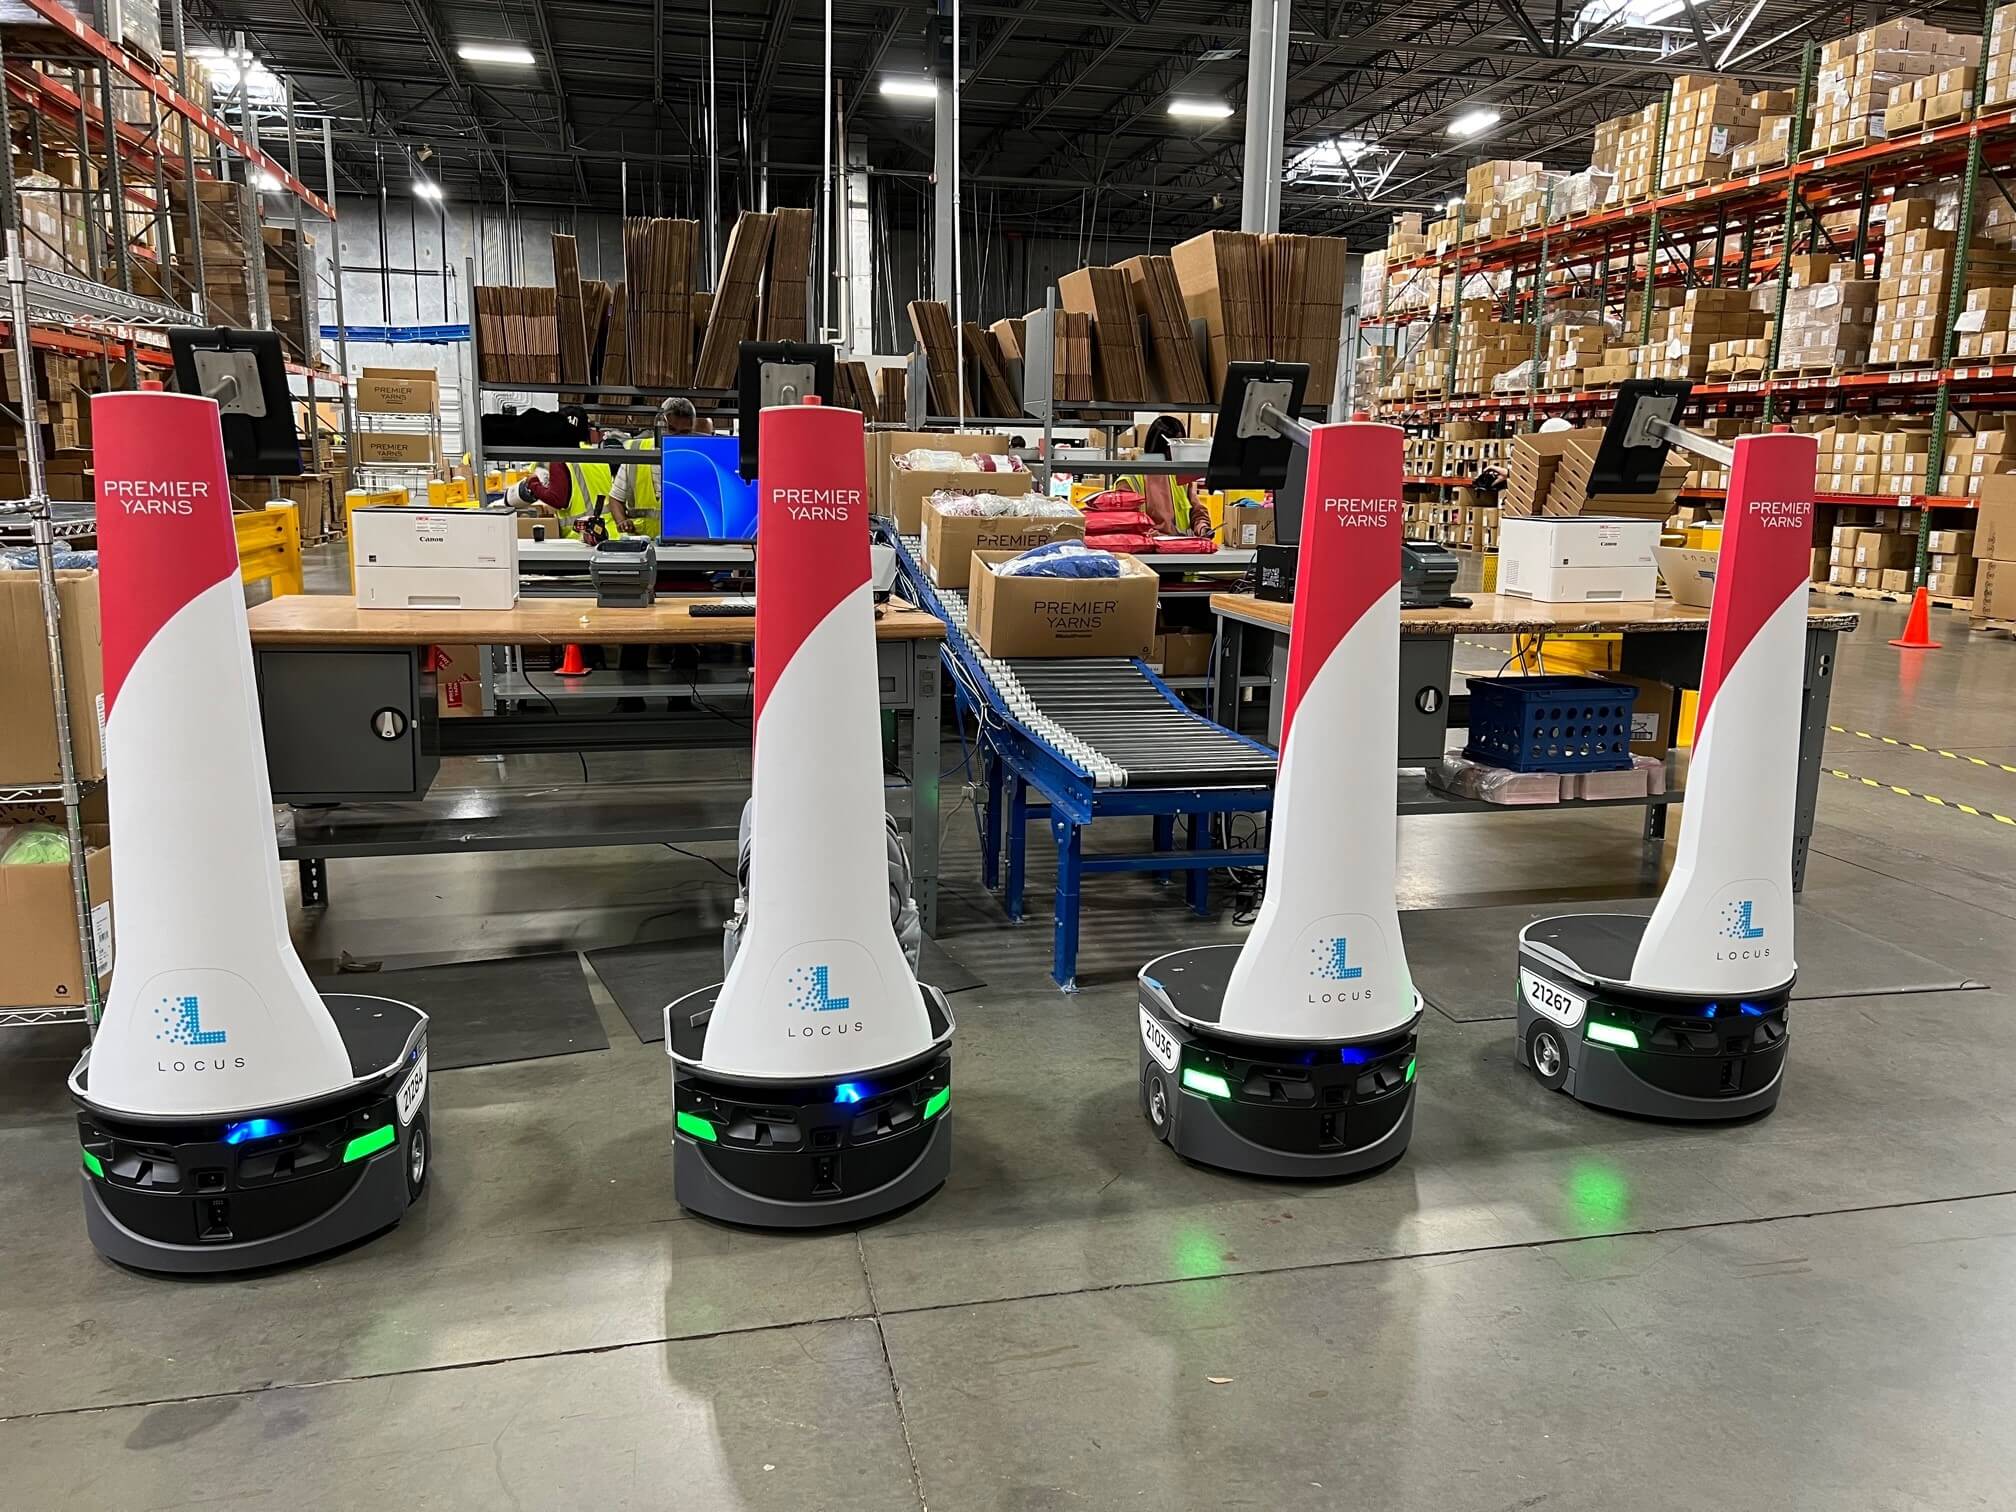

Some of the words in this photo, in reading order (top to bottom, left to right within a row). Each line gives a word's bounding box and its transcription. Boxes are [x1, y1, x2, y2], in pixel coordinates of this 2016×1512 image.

[374, 386, 412, 394] PREMIER
[370, 443, 408, 451] PREMIER
[104, 480, 209, 498] PREMIER
[773, 488, 861, 505] PREMIER
[120, 499, 193, 515] YARNS
[1324, 498, 1397, 513] PREMIER
[1749, 502, 1811, 515] PREMIER
[788, 506, 849, 521] YARNS
[1337, 514, 1387, 528] YARNS
[1760, 516, 1803, 528] YARNS
[976, 534, 1048, 547] PREMIER
[1033, 601, 1117, 615] PREMIER
[1046, 616, 1102, 629] YARNS
[1716, 948, 1770, 961] LOCUS
[1308, 989, 1372, 1003] LOCUS
[1532, 981, 1571, 1014] 21267
[788, 1021, 863, 1037] LOCUS
[1146, 1019, 1171, 1059] 21036
[158, 1057, 245, 1072] LOCUS
[403, 1065, 424, 1113] 21284
